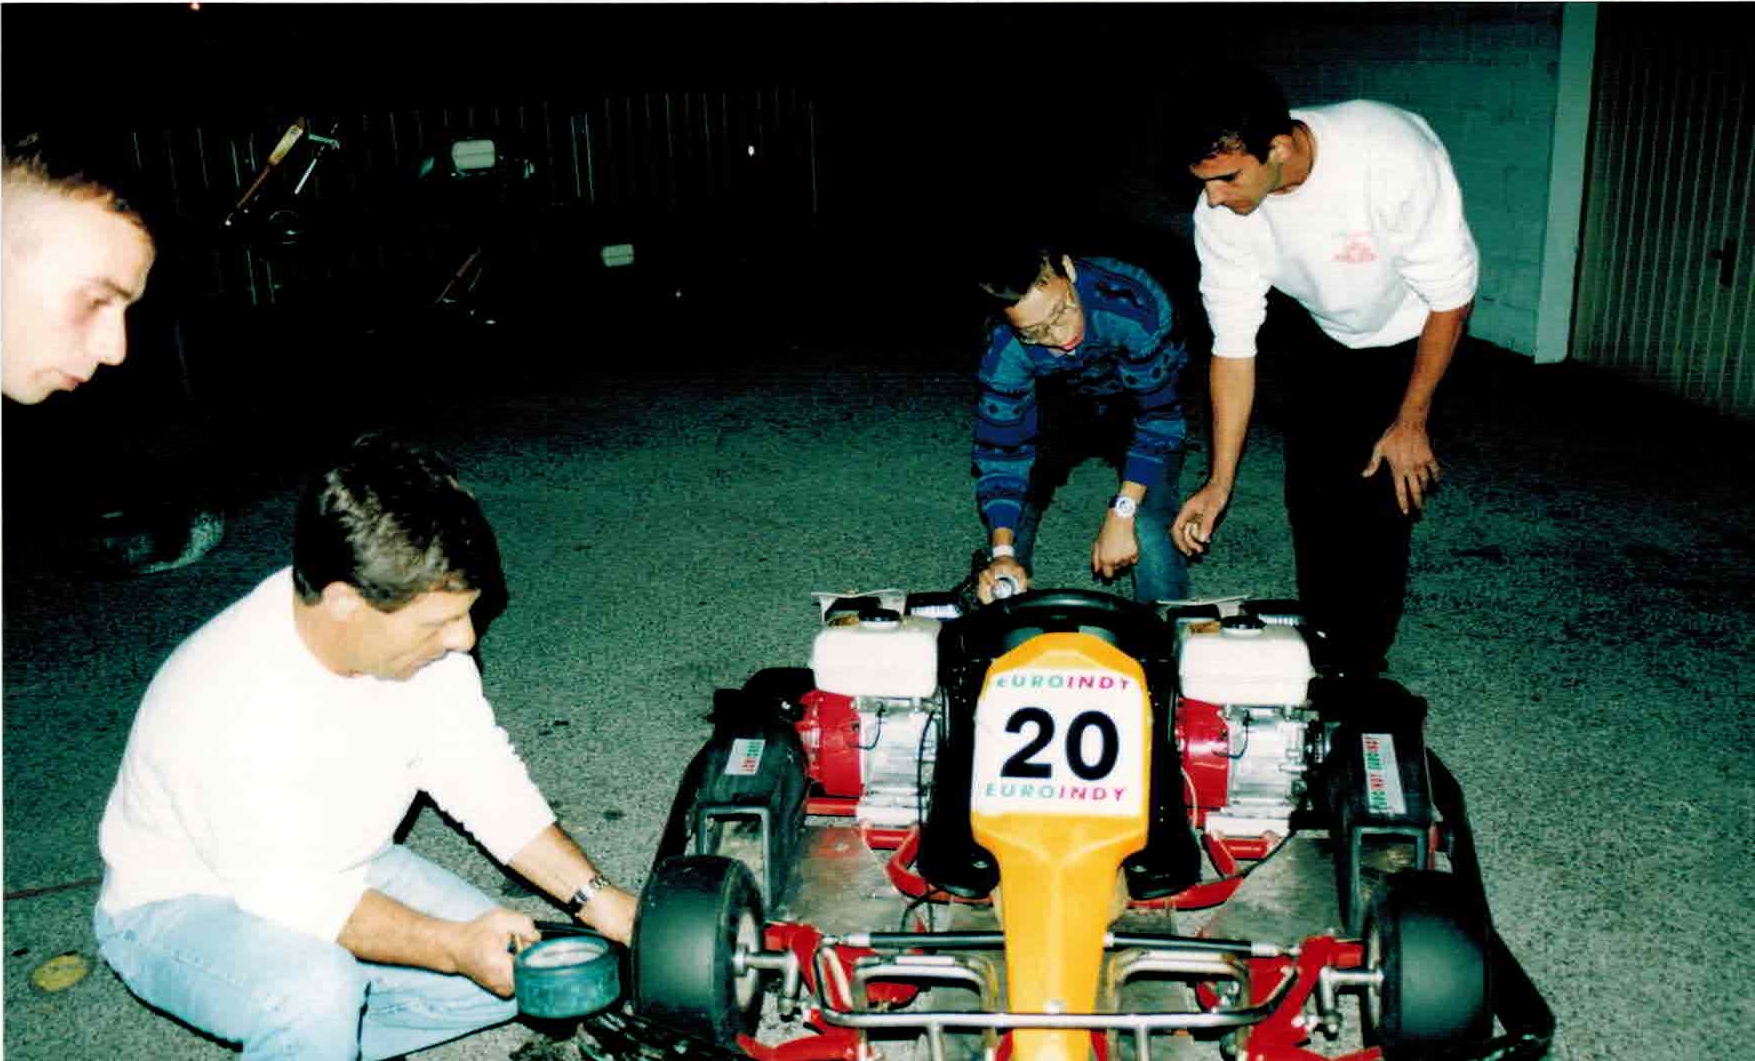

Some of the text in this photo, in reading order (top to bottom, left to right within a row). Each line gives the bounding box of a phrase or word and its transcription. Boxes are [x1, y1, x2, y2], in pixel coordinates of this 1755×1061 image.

[996, 674, 1131, 690] EUROINDY
[1000, 706, 1120, 782] 20
[985, 783, 1127, 801] EUROINDY
